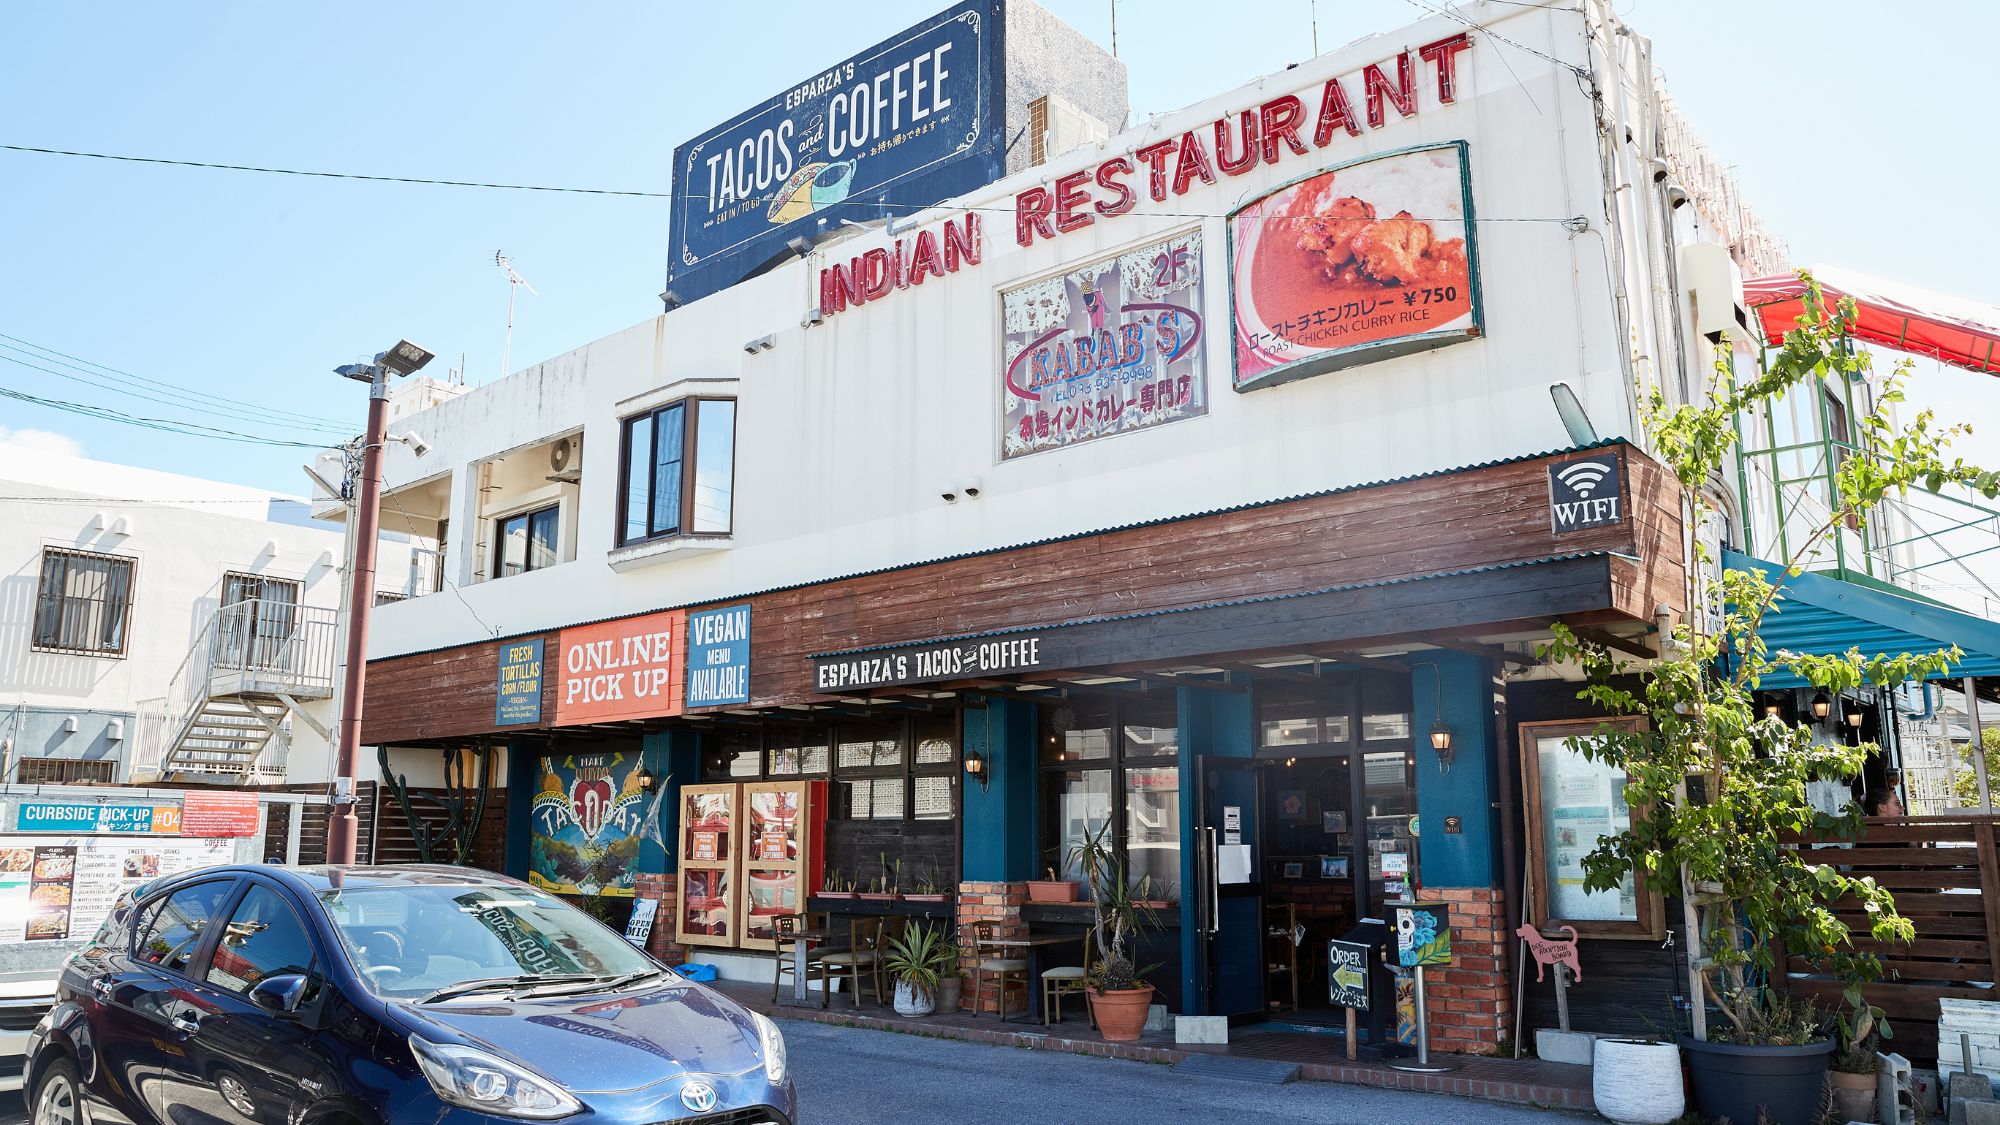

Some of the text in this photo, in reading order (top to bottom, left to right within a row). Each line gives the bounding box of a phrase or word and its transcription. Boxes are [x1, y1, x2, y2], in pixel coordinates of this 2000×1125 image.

[786, 62, 855, 111] ESPARZA'S
[706, 41, 952, 213] TACOS and COFFEE
[870, 120, 936, 156] お持ち帰りできます
[820, 33, 1473, 316] INDIAN RESTAURANT
[716, 210, 728, 225] EAT
[729, 207, 736, 219] IN
[742, 201, 750, 213] TO
[751, 197, 760, 209] GO
[1153, 246, 1188, 288] 2F
[1249, 299, 1394, 350] ローストチキンカレー
[1263, 308, 1431, 358] ROAST CHICKEN CURRY RICE
[1553, 496, 1619, 526] WIFI
[693, 610, 747, 646] VEGAN
[509, 645, 533, 664] FRESH
[567, 631, 670, 674] ONLINE
[706, 647, 731, 666] MENU
[819, 654, 907, 688] ESPARZA'S
[915, 647, 962, 678] TACOS
[979, 637, 1040, 671] COFFEE
[501, 661, 540, 682] TORTILLAS
[690, 664, 746, 702] AVAILABLE
[502, 680, 537, 696] CORN/FLOUR
[566, 667, 669, 705] PICK UP
[580, 756, 604, 767] MAKE
[26, 806, 96, 821] CURBSIDE
[100, 808, 150, 822] PICK-UP
[134, 823, 150, 831] 番号
[204, 839, 228, 847] COFFEE
[626, 927, 649, 937] MIC
[629, 919, 651, 928] OPEN
[1330, 945, 1361, 967] ORDER
[1531, 941, 1544, 951] DOG
[1551, 950, 1572, 961] BOARD
